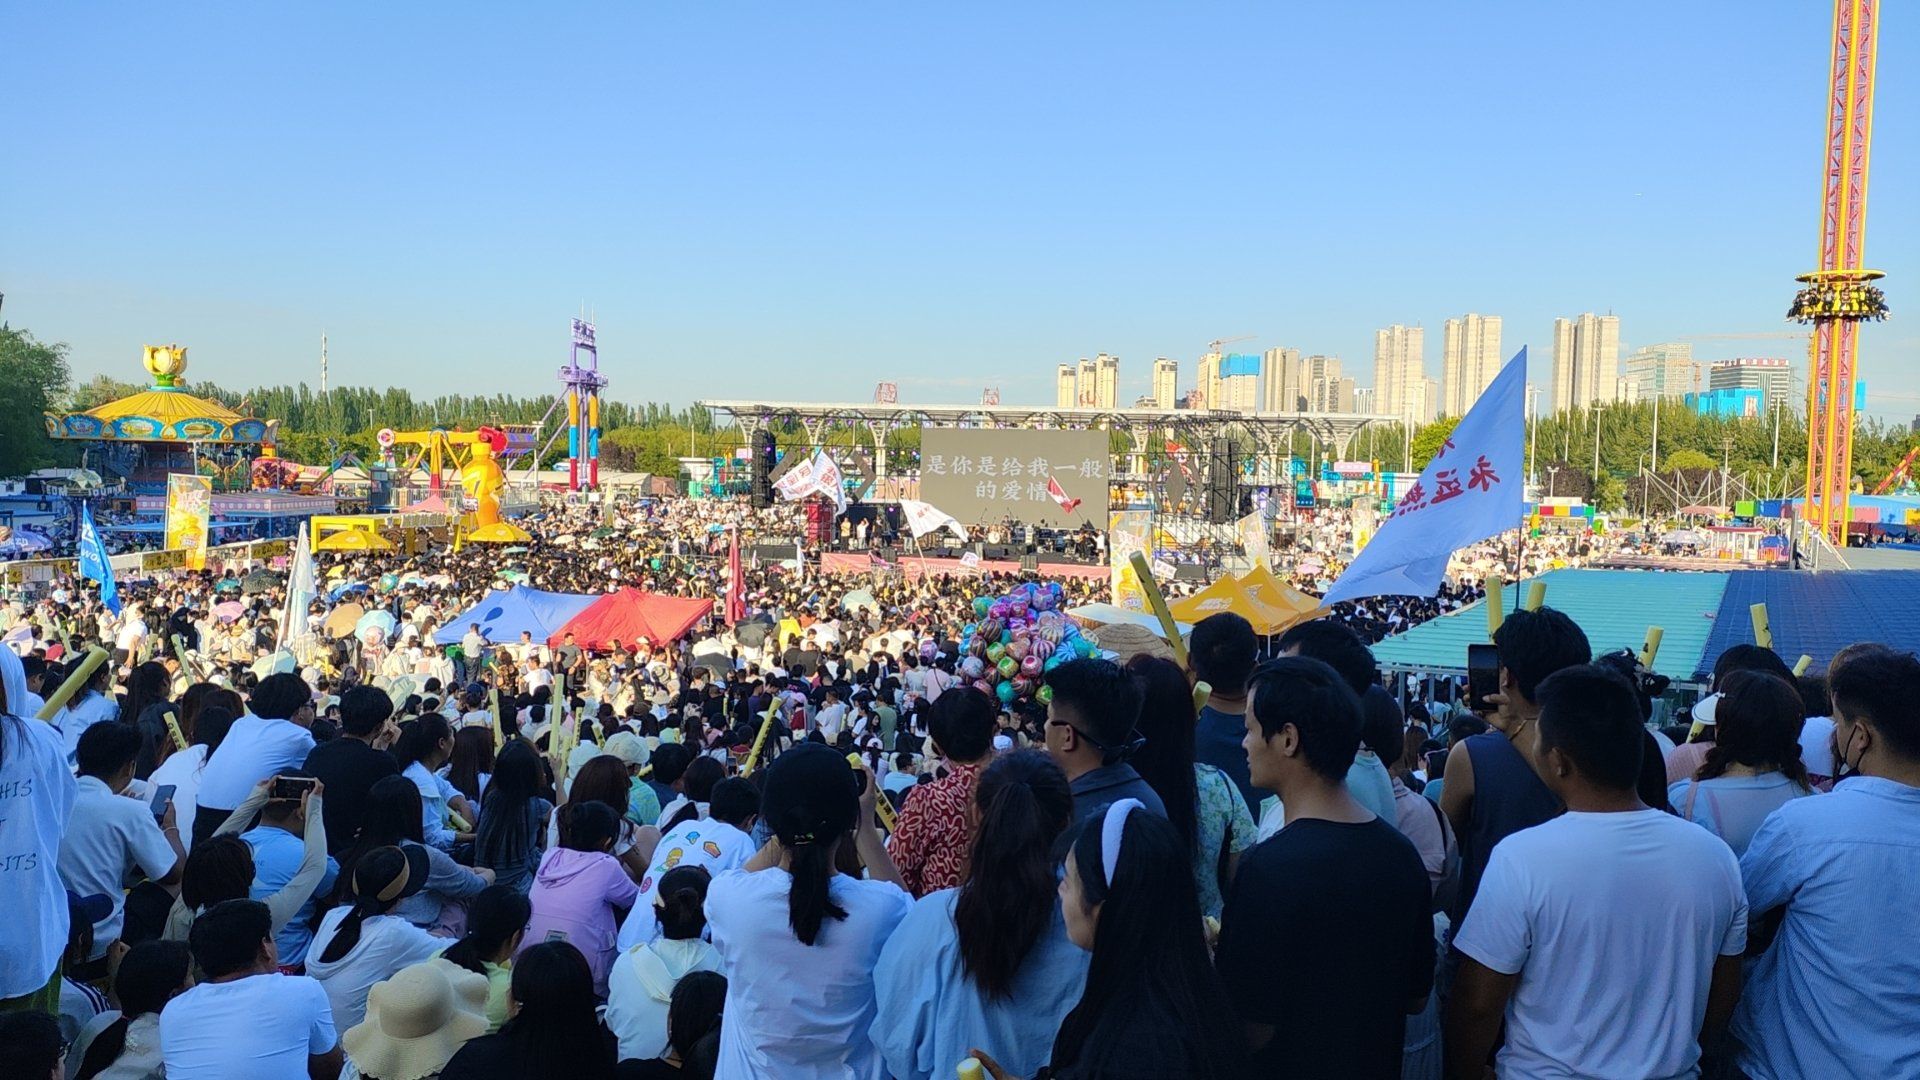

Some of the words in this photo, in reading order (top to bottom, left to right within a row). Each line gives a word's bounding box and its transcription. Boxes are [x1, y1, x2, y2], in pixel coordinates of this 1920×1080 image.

[926, 454, 1104, 479] 是你是给我一般
[975, 480, 1047, 502] 的爱情
[0, 852, 37, 872] ITS
